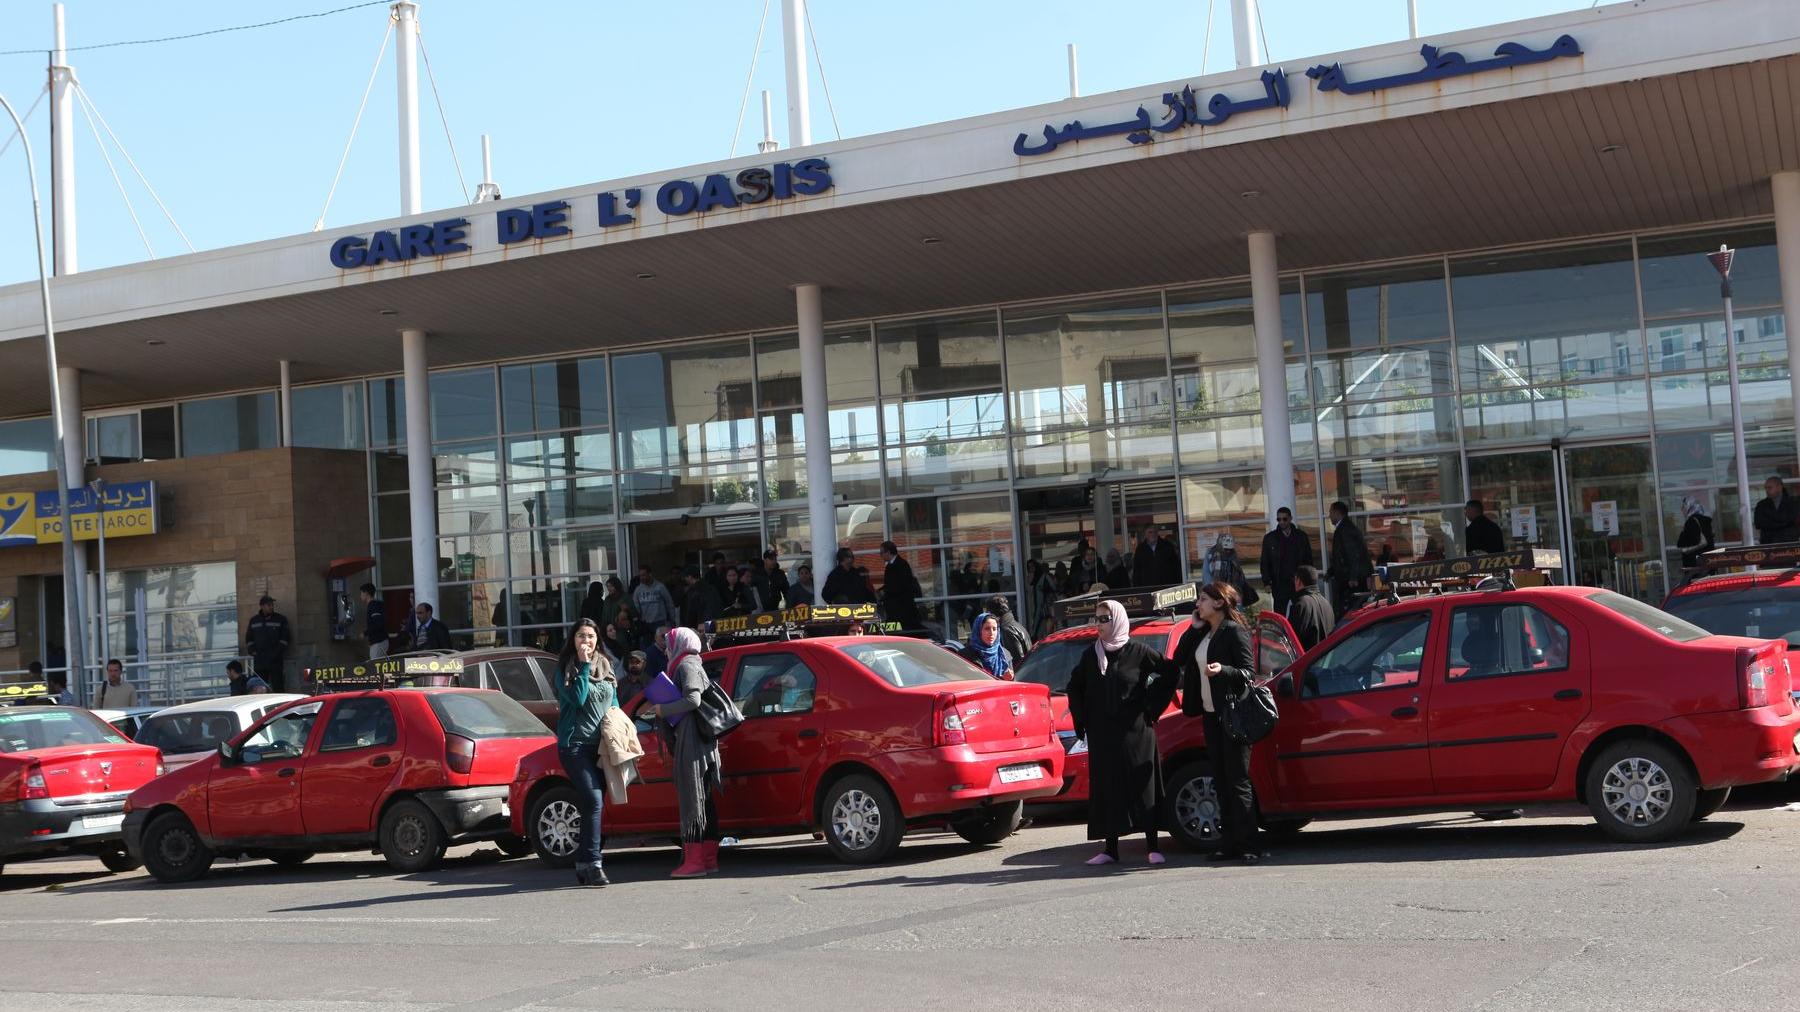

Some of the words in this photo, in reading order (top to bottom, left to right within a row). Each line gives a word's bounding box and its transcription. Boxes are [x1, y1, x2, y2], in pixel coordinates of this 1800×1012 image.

[1306, 34, 1584, 94] محطة
[330, 218, 471, 269] GARE
[497, 200, 572, 245] DE
[598, 188, 641, 228] L'
[656, 158, 834, 217] OASIS
[43, 518, 92, 535] POTE
[1400, 563, 1445, 579] PETIT
[1478, 553, 1523, 570] TAXI
[715, 616, 748, 634] PETIT
[781, 605, 809, 623] TAXI
[315, 666, 346, 681] PETIT
[374, 661, 401, 674] TAXI
